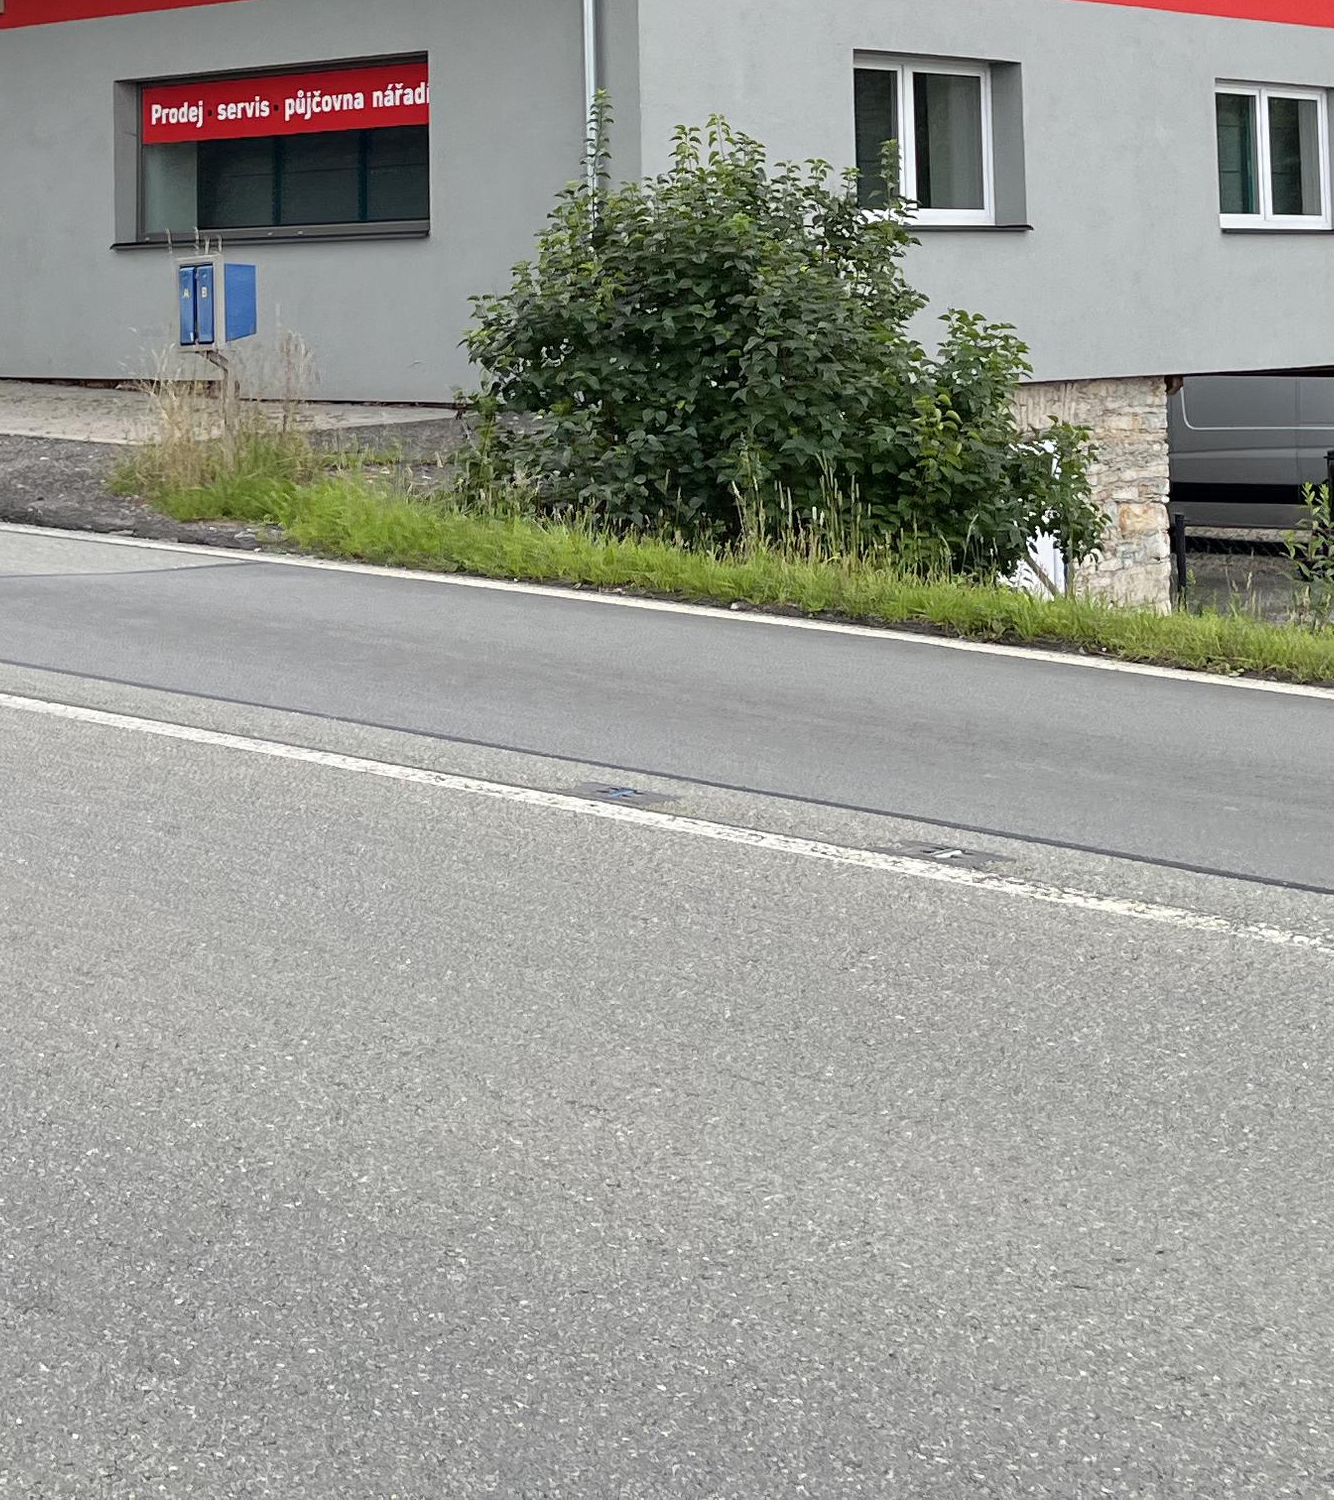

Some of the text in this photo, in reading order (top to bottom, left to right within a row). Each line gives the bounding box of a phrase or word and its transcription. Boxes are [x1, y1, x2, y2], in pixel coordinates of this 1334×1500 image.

[151, 100, 204, 128] Prodej
[217, 96, 271, 121] servis
[284, 89, 365, 122] půjčovna
